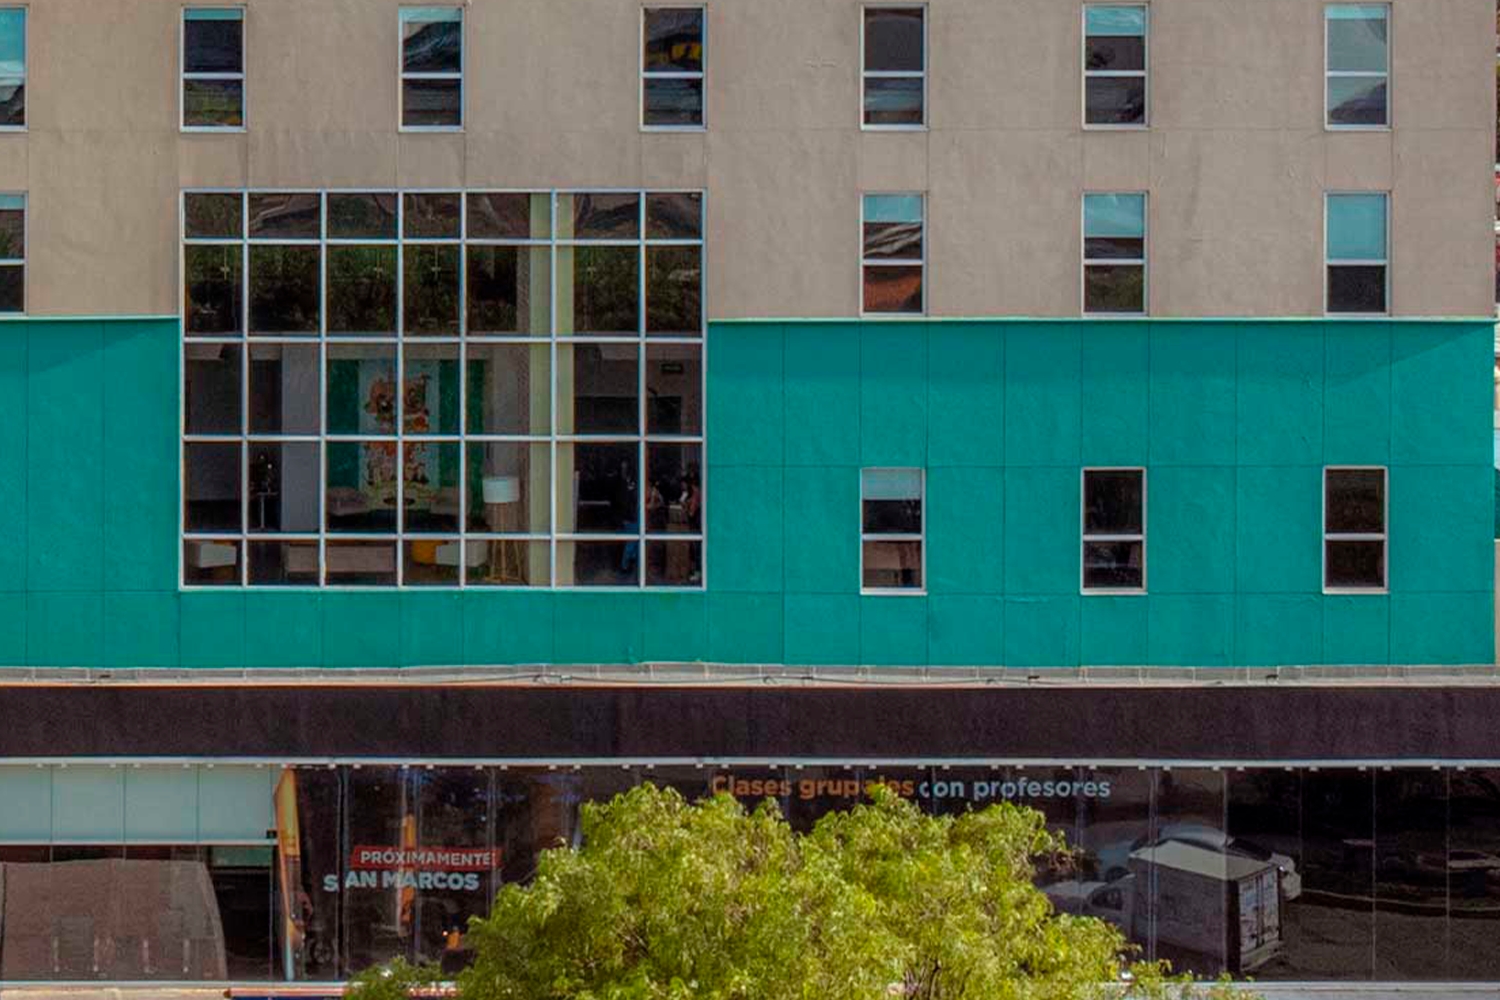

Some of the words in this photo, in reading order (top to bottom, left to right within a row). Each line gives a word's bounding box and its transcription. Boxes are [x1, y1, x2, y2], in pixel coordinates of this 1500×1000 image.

[712, 775, 791, 797] Clases
[919, 781, 965, 797] con
[973, 777, 1111, 800] profesores
[360, 847, 496, 867] PRÓXIMAMENTE
[323, 870, 377, 892] SAN
[382, 870, 480, 891] MARCOS
